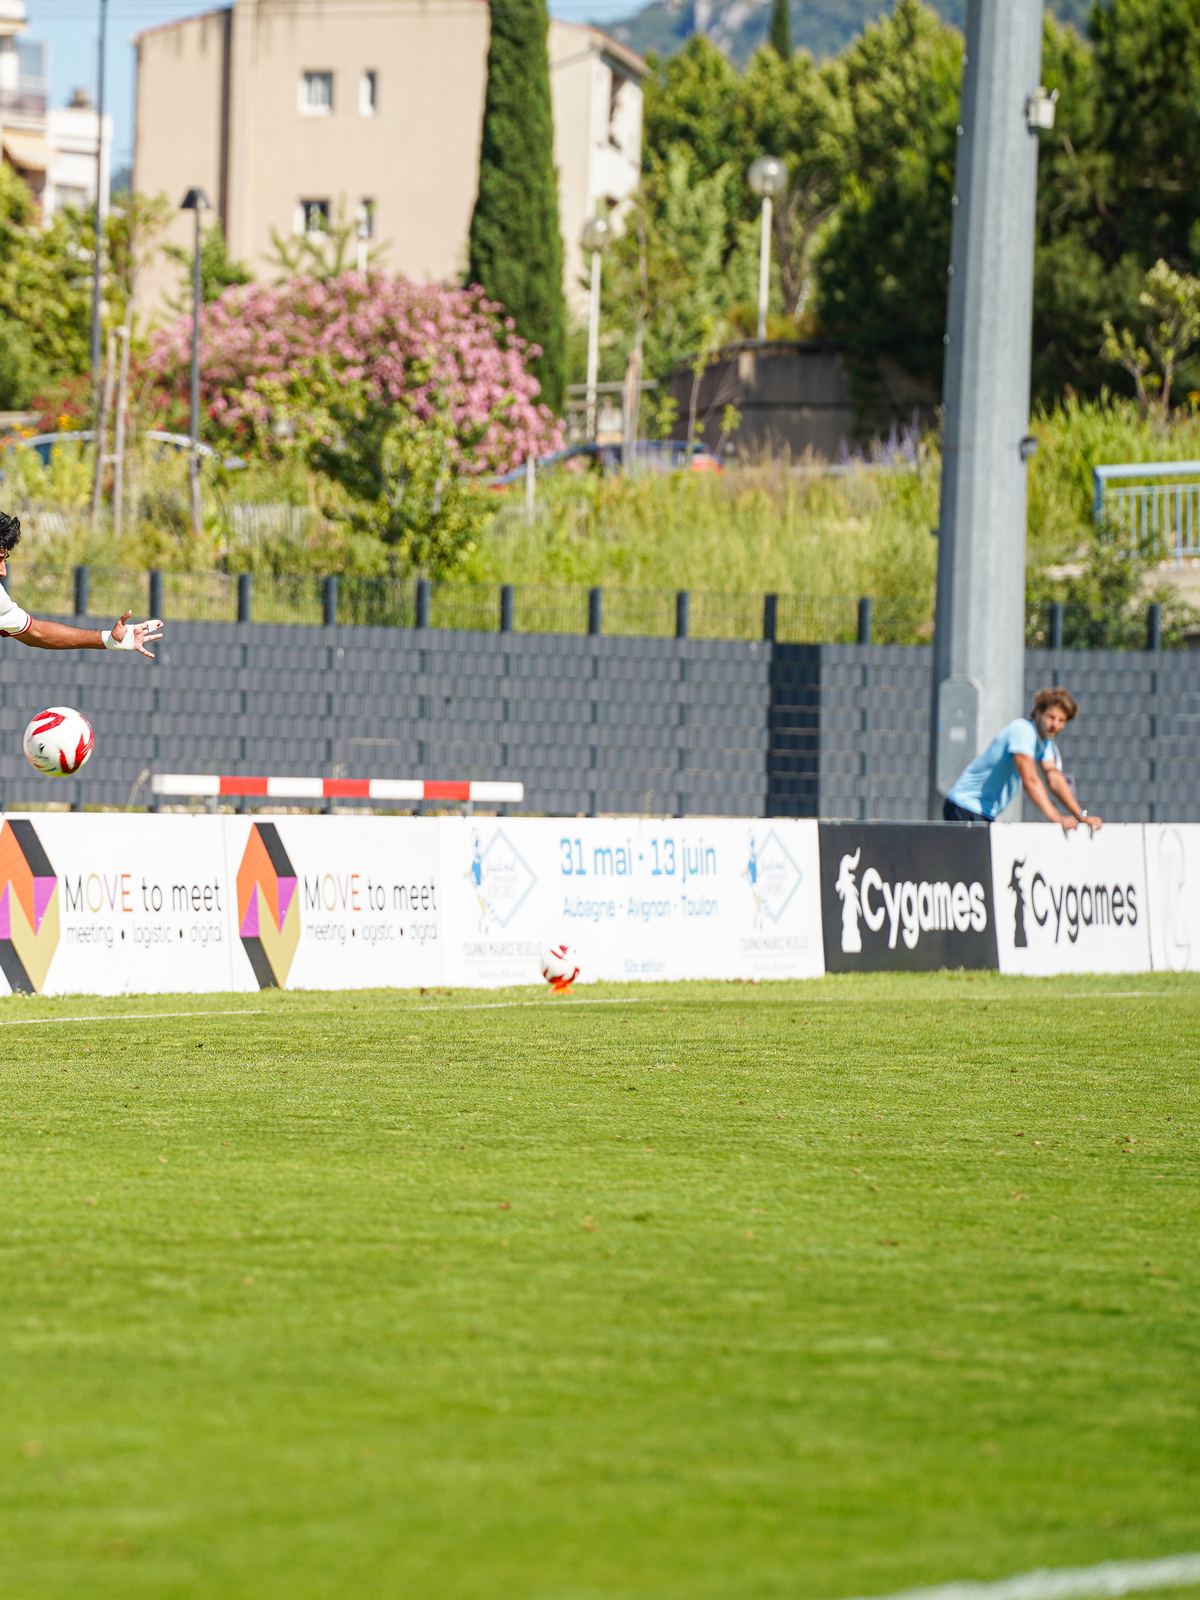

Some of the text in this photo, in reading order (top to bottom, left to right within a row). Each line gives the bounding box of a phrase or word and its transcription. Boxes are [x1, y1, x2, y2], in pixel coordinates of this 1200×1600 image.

[560, 838, 586, 875] 31
[594, 837, 632, 876] mai
[650, 838, 675, 876] 13
[681, 837, 717, 884] juin
[65, 872, 222, 912] MOVE to meet
[304, 873, 437, 911] MOVE to meet
[563, 895, 718, 922] Aubagne Avignon Toulon
[860, 867, 988, 949] Cygames
[1031, 871, 1138, 944] Cygames
[66, 922, 114, 948] meeting
